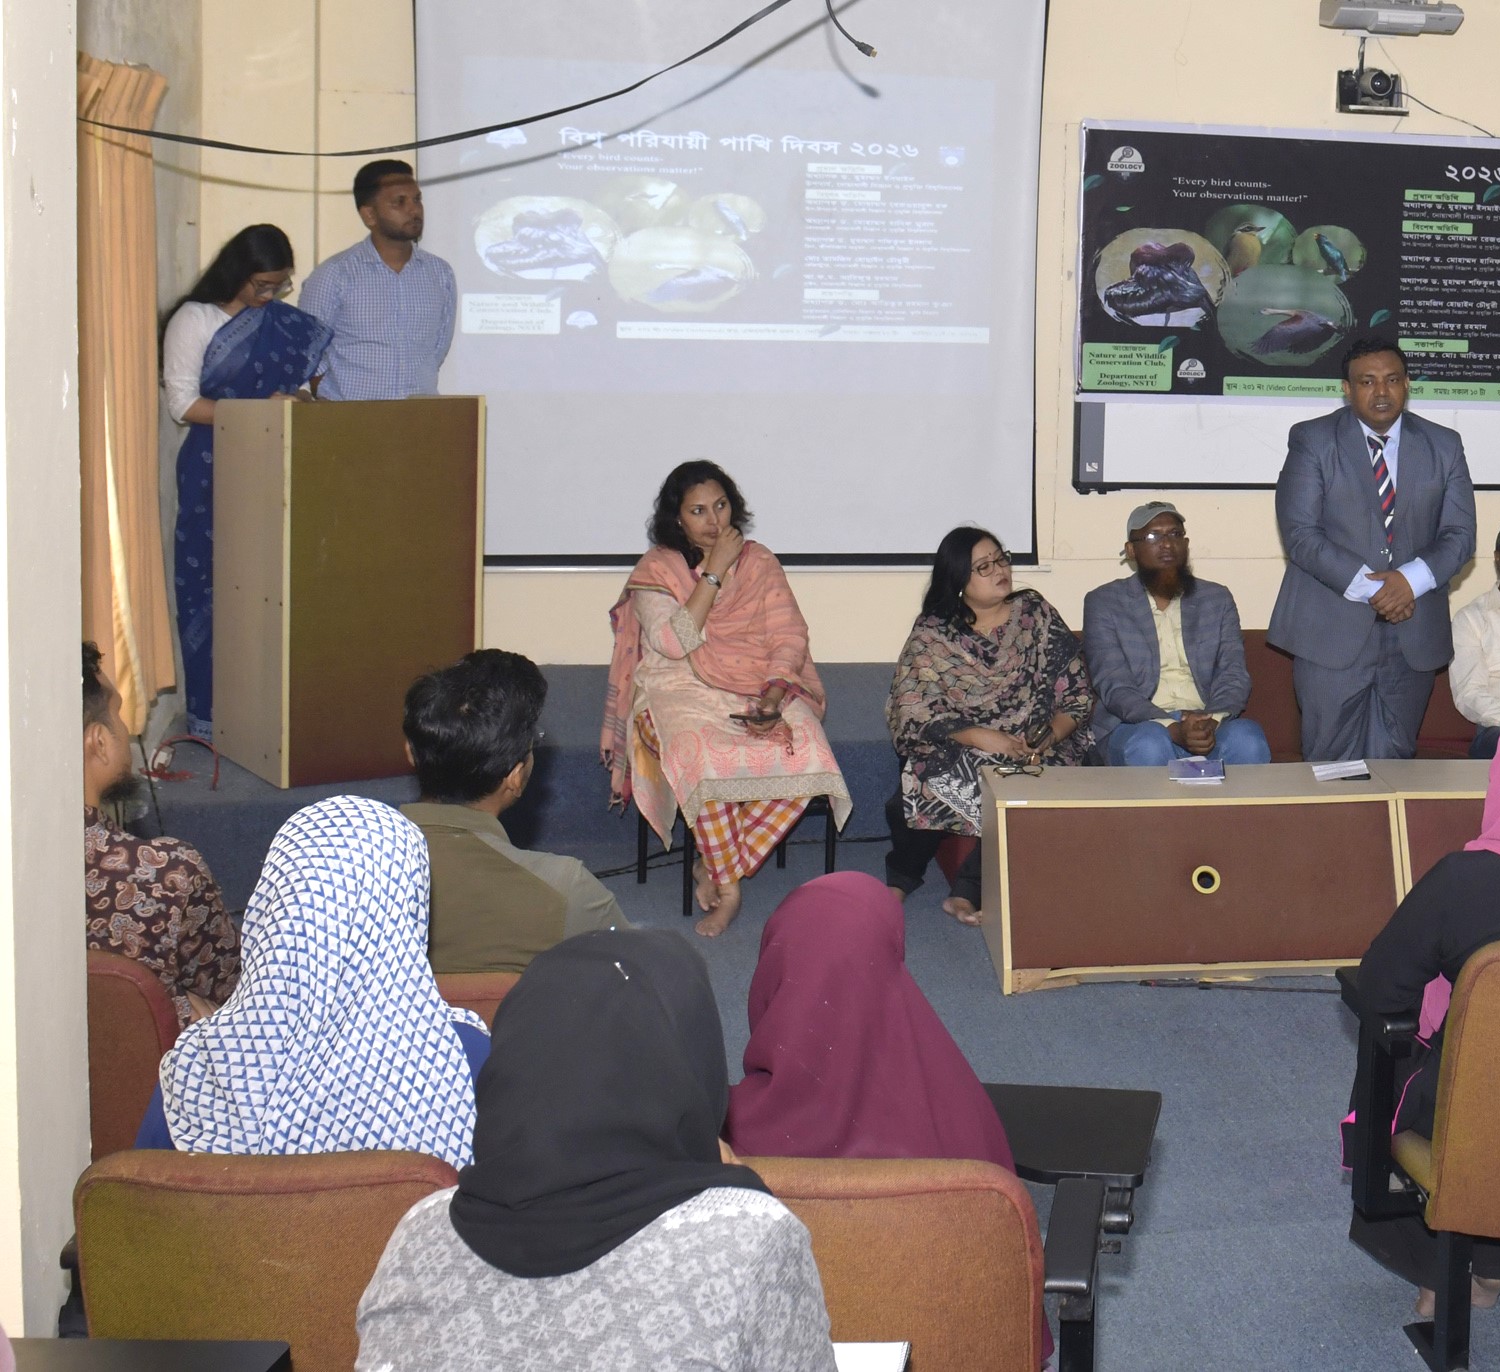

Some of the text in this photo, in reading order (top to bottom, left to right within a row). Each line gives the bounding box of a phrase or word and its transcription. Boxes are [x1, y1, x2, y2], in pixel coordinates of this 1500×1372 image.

[558, 127, 919, 158] বিশ্ব পরিযায়ী পাখি দিবস ২০২৬
[598, 153, 620, 162] bird
[557, 162, 584, 171] Your
[1109, 162, 1143, 171] ZOOLOGY
[1211, 177, 1231, 187] bird
[1234, 180, 1271, 189] counts-
[1172, 189, 1198, 199] Your
[1199, 190, 1265, 201] observations
[1088, 351, 1167, 361] Nature and Wildlife
[1088, 358, 1166, 368] Conservation Club,
[1099, 372, 1159, 382] Department of
[1096, 378, 1158, 388] Zoology, NSTU
[1287, 385, 1324, 394] Conference)
